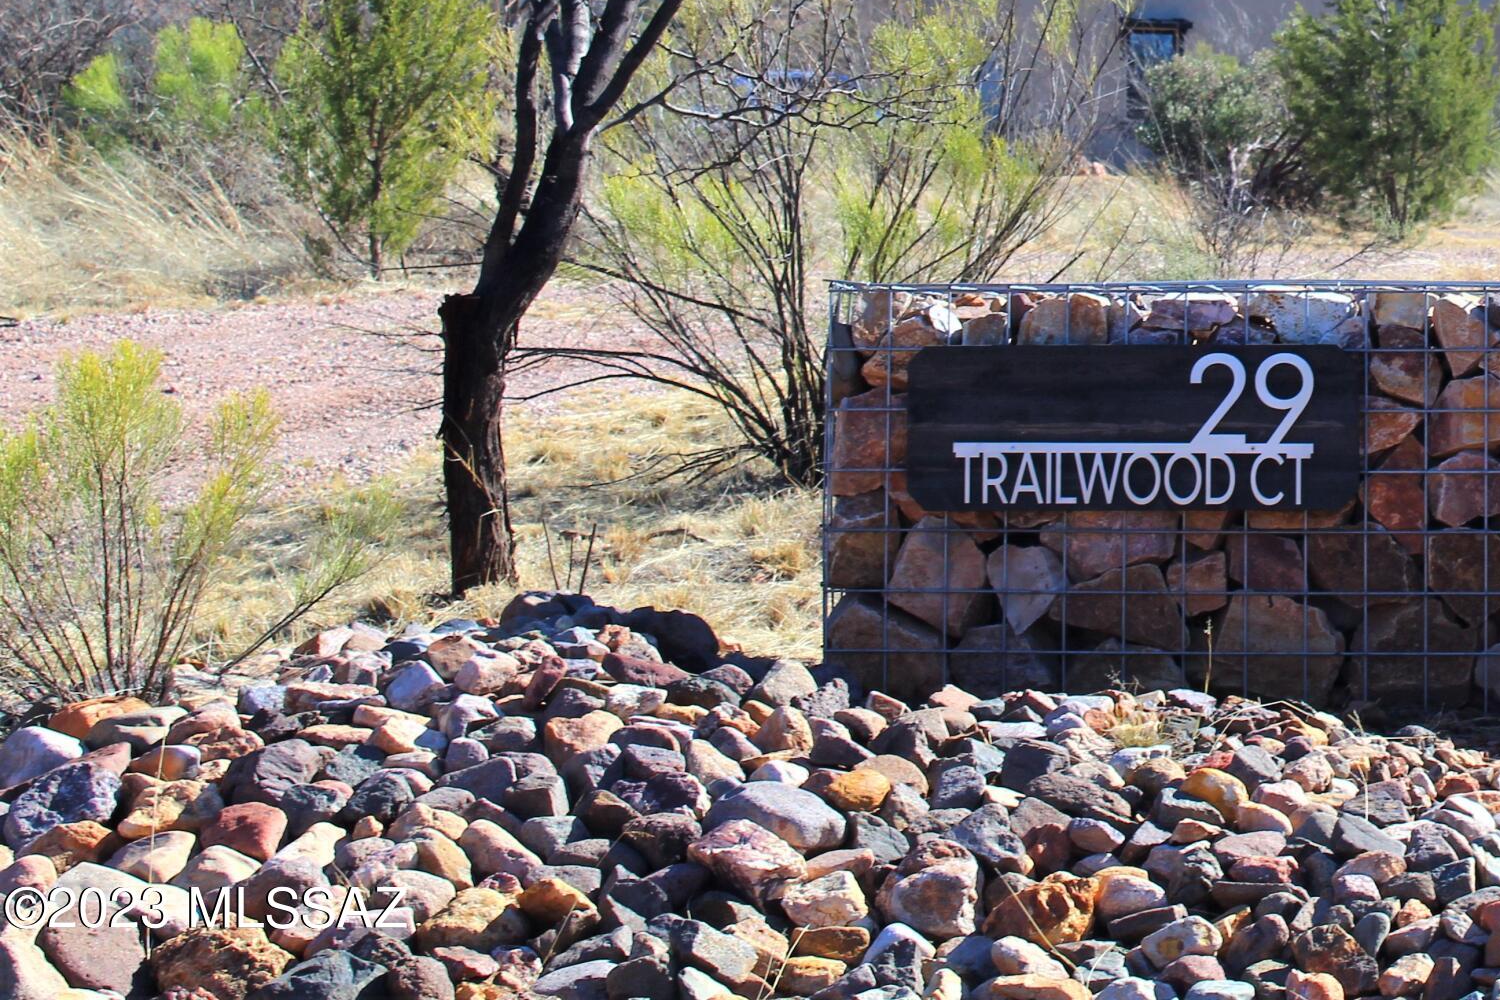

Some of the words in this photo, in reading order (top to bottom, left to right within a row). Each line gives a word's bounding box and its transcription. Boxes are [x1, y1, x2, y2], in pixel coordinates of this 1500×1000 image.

[1189, 352, 1315, 446] 29
[954, 450, 1236, 506] TRAILWOOD
[1249, 450, 1312, 506] CT
